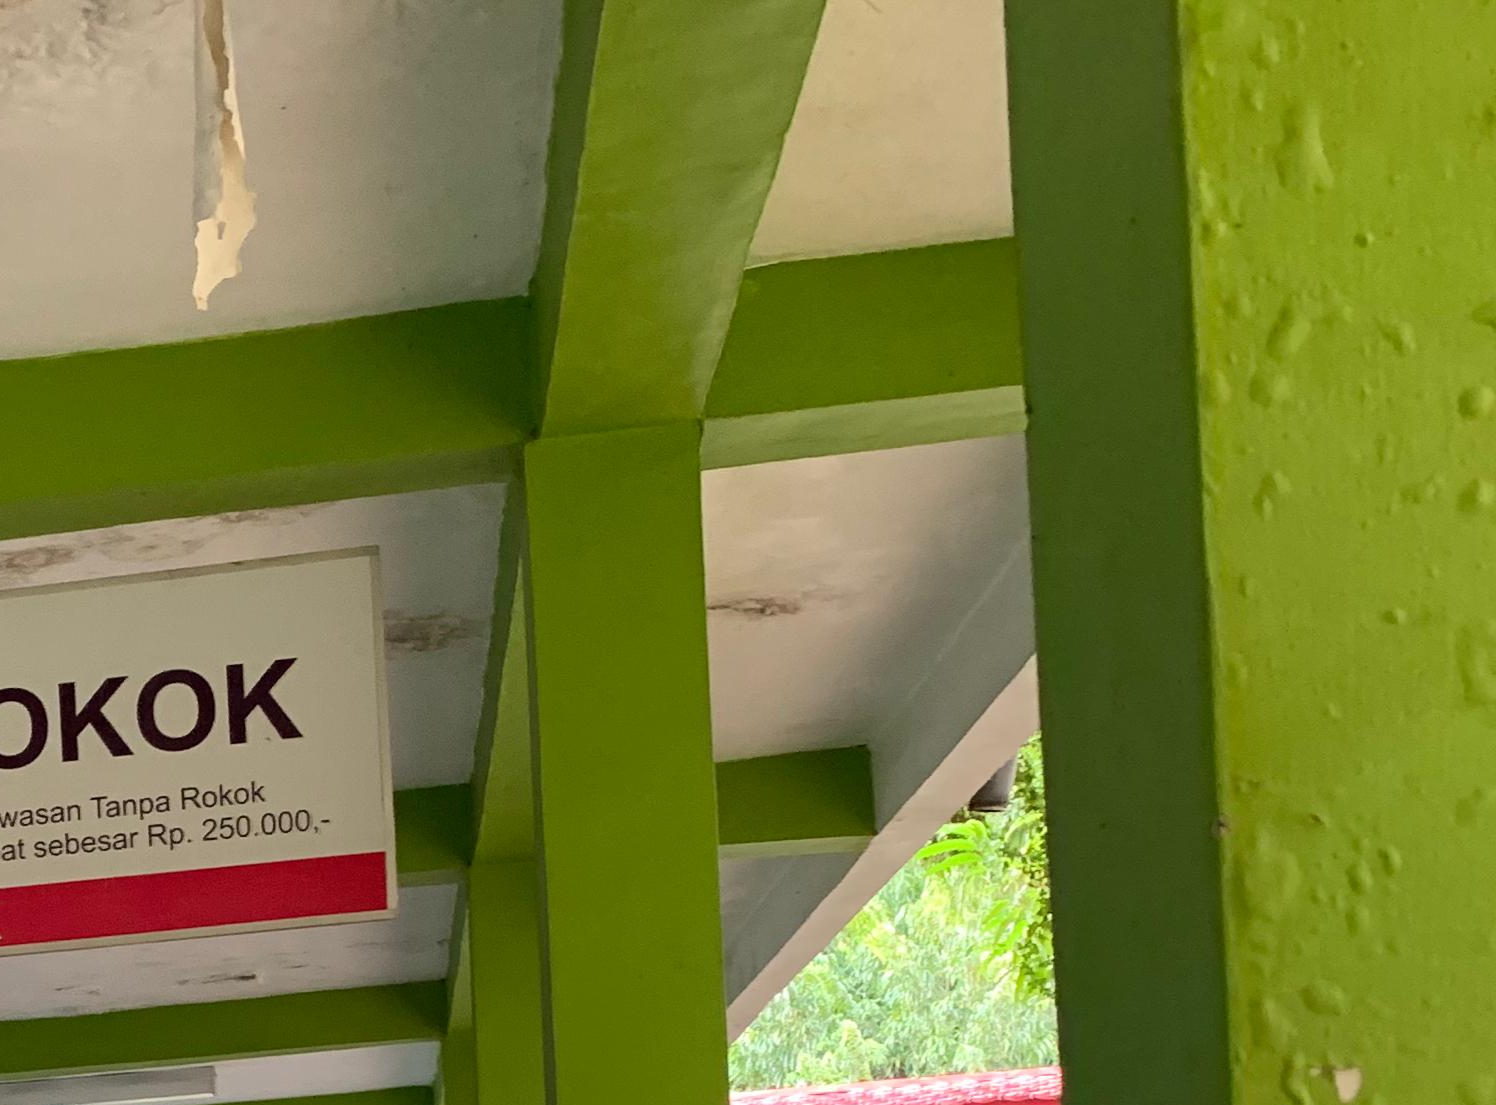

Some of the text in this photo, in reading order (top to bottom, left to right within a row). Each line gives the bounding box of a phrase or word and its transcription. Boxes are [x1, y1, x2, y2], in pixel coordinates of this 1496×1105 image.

[90, 796, 170, 820] Tanpa
[181, 781, 266, 810] Rokok
[34, 832, 138, 858] sebesar
[148, 824, 192, 850] Rp.
[203, 809, 330, 841] 250.000,-
